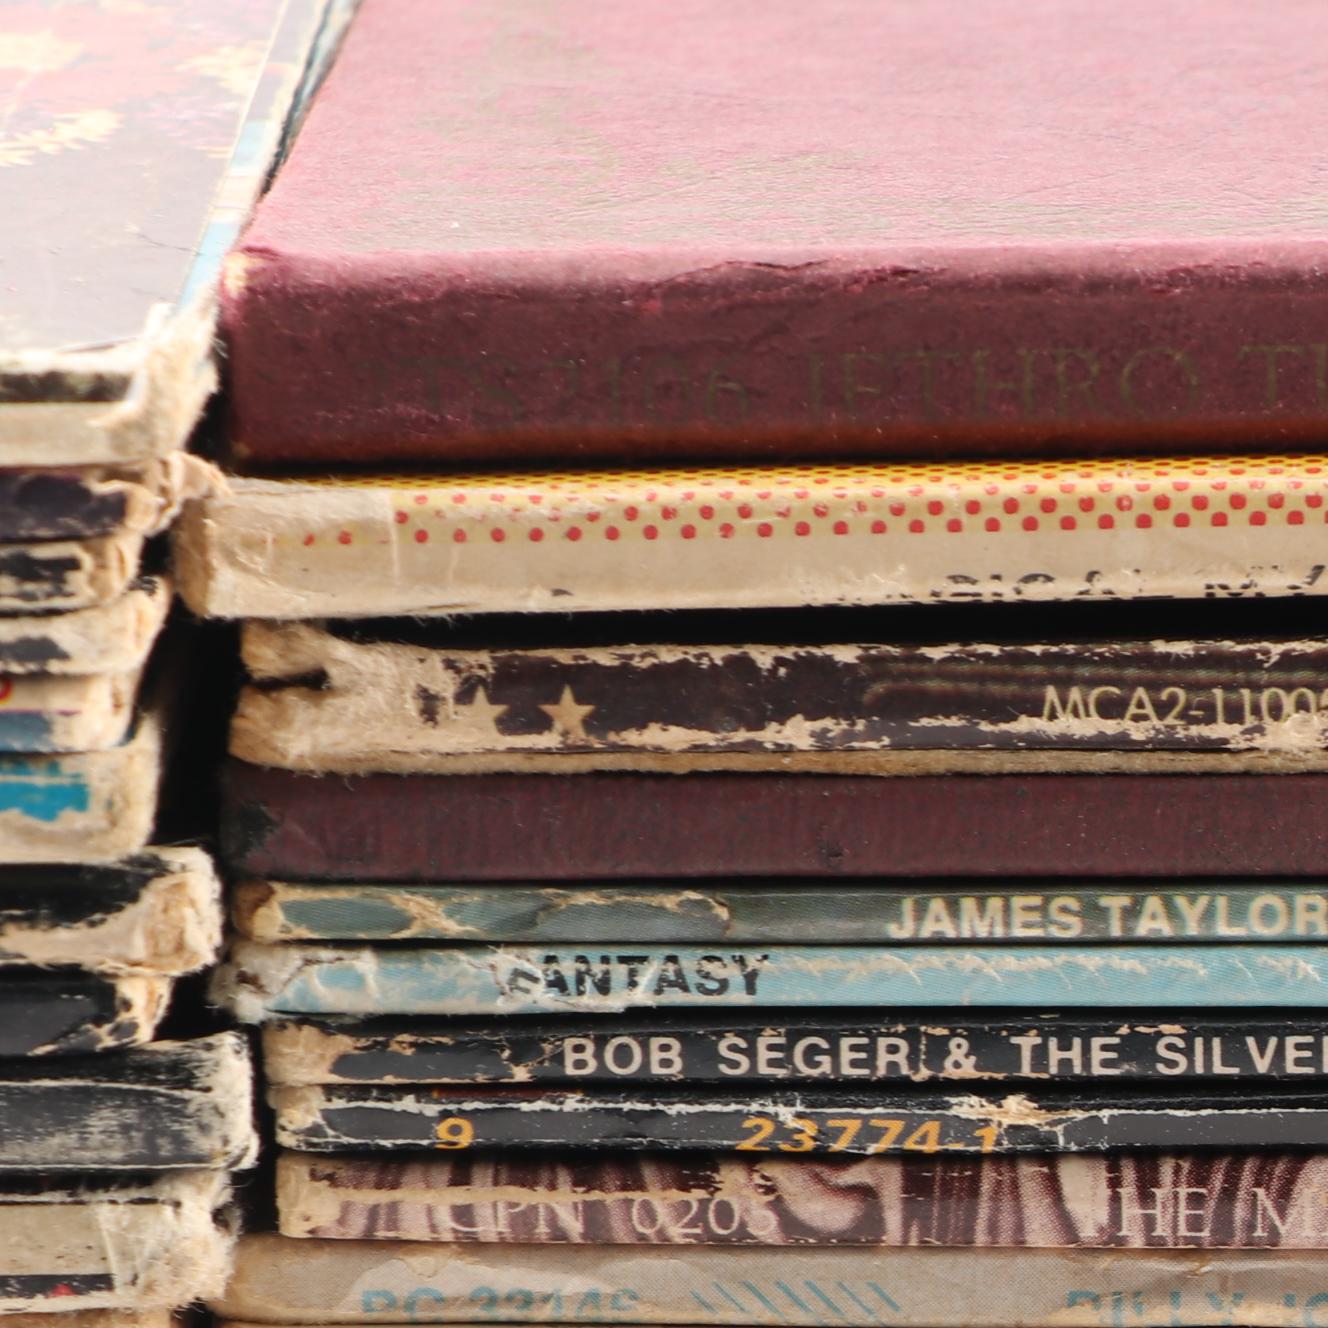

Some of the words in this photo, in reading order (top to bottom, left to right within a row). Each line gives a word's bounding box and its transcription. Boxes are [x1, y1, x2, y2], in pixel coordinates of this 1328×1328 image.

[886, 893, 1083, 938] JAMES
[1098, 891, 1328, 938] TAYLOR
[562, 1035, 684, 1077] BOB
[716, 1034, 911, 1077] SEGER
[941, 1036, 978, 1074] &
[1008, 1034, 1122, 1077] THE
[435, 1116, 475, 1150] 9
[734, 1117, 999, 1154] 23774-1
